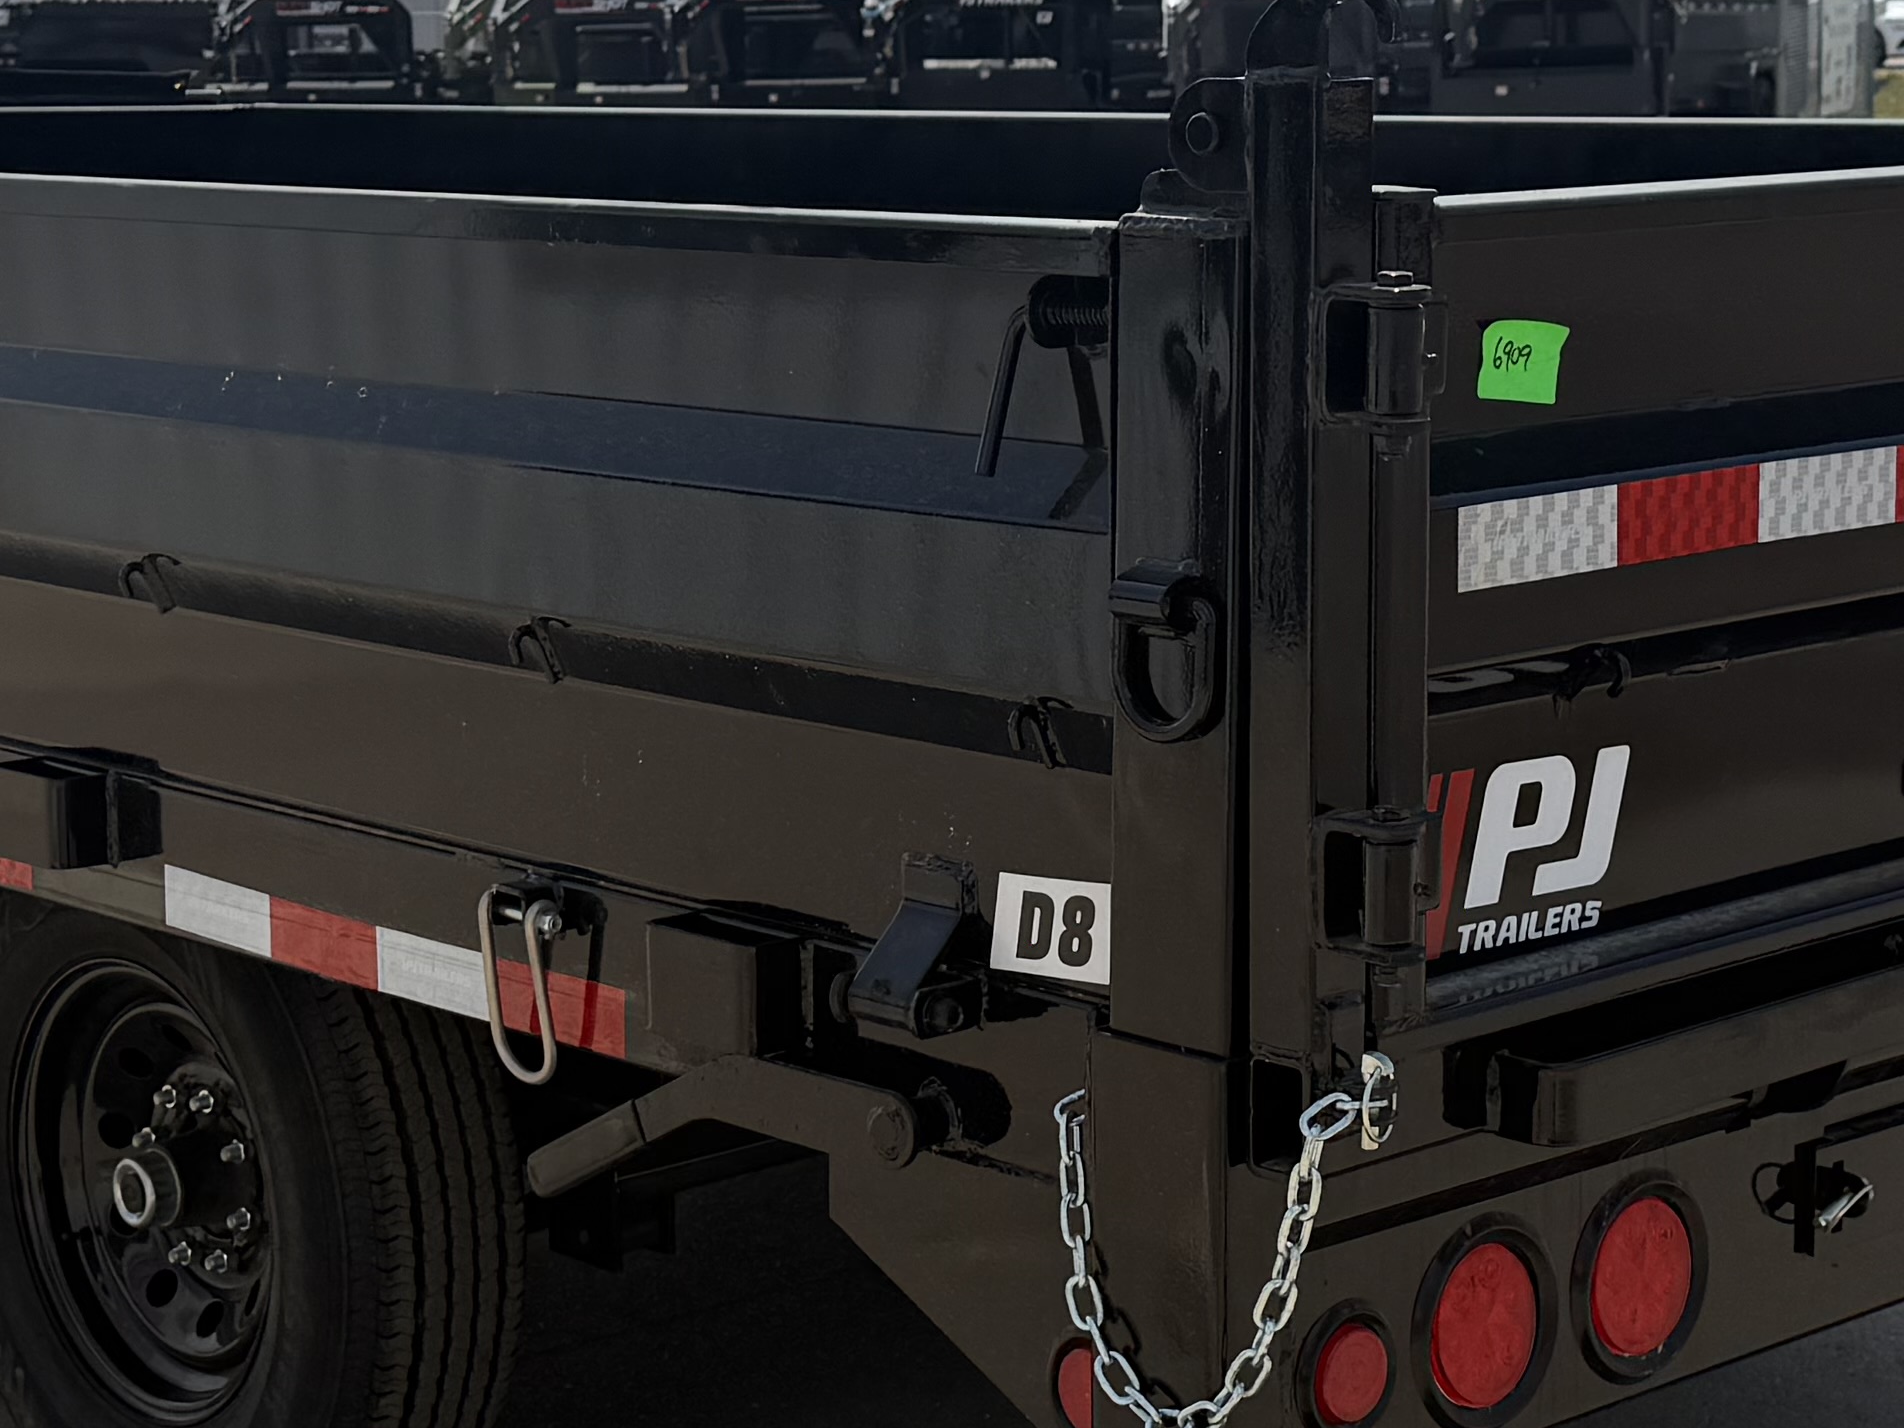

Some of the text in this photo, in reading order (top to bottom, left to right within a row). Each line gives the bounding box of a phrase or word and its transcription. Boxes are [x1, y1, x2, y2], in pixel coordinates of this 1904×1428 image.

[1493, 336, 1532, 372] 6909
[1464, 745, 1630, 909] PJ
[1016, 890, 1095, 967] D8
[1457, 900, 1602, 954] TRAILERS
